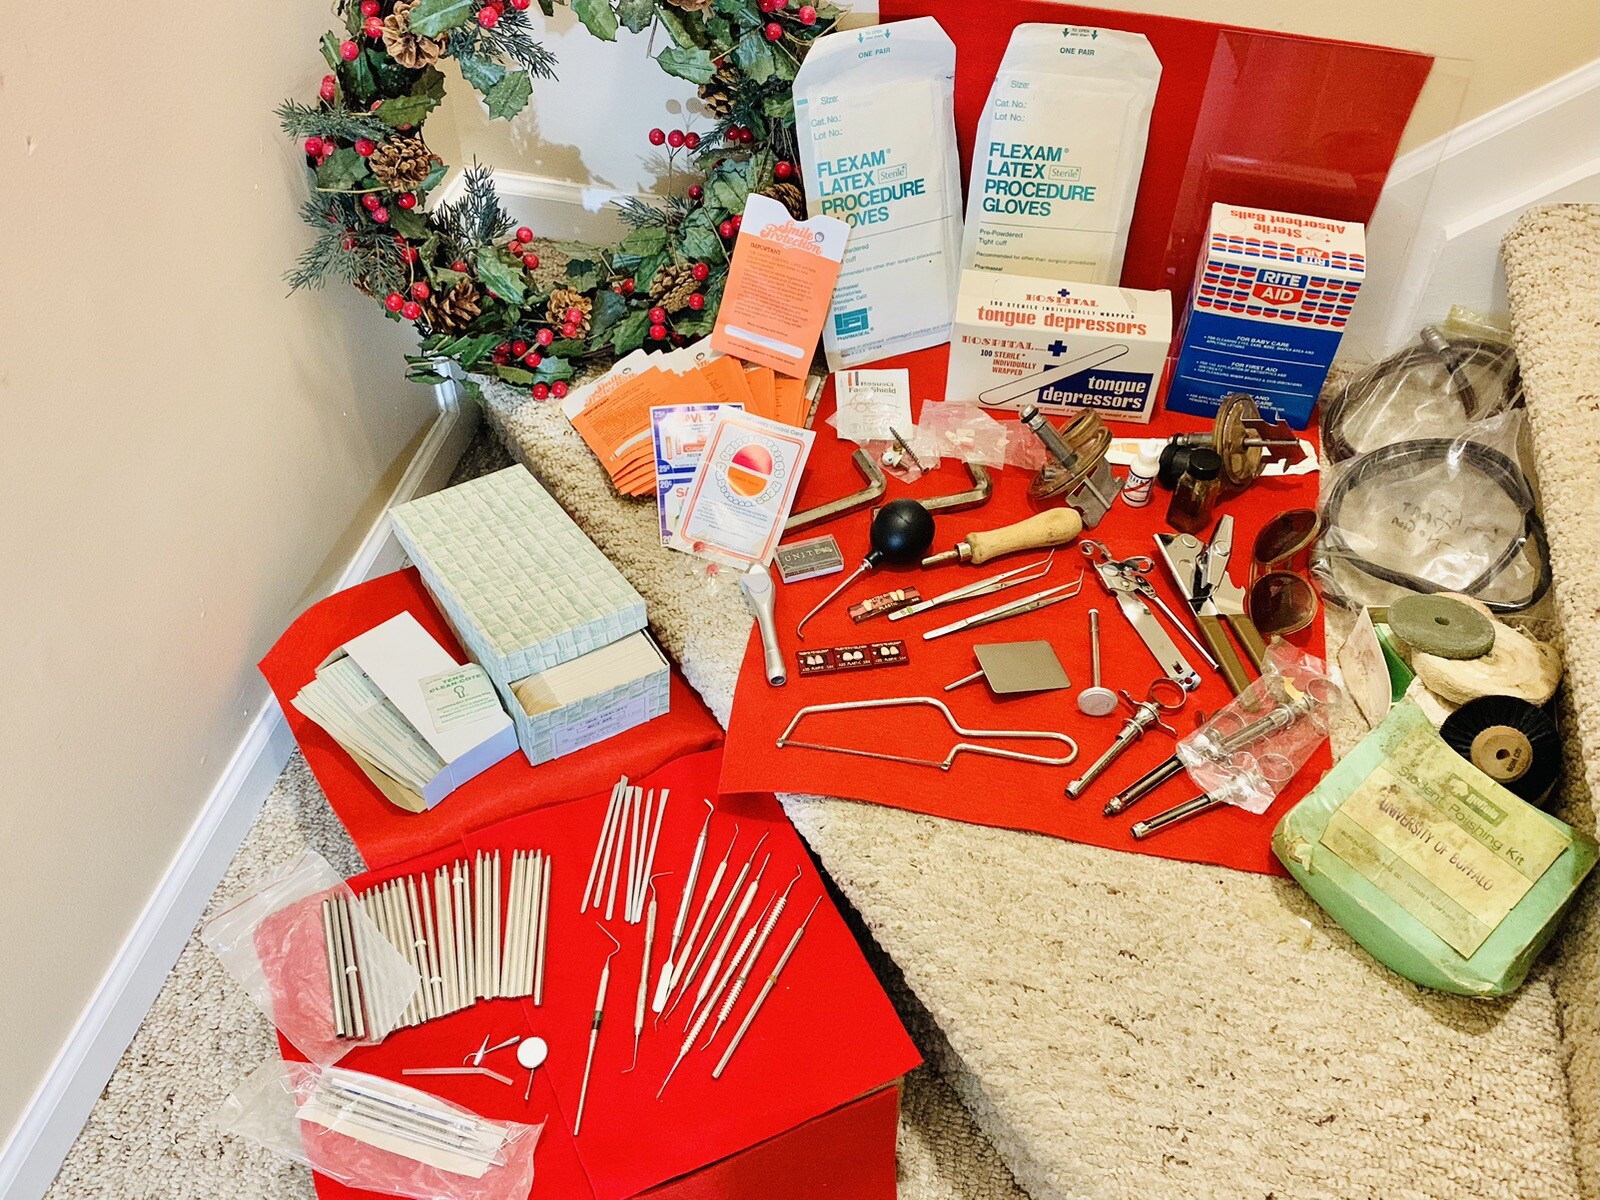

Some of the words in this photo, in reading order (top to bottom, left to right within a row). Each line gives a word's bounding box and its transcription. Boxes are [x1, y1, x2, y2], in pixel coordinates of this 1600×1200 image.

[858, 50, 872, 59] ONE
[875, 47, 891, 55] PAIR
[1059, 47, 1075, 55] ONE
[1077, 48, 1096, 56] PAIR
[1010, 80, 1030, 89] Size:
[820, 95, 839, 105] Size:
[994, 112, 1008, 121] Lot
[813, 130, 827, 141] Lot
[987, 160, 1046, 179] LATEX
[819, 171, 876, 197] LATEX
[985, 179, 1096, 201] PROCEDURE
[821, 178, 926, 215] PROCEDURE
[983, 197, 1051, 217] GLOVES
[1230, 210, 1267, 222] Balls
[1270, 213, 1346, 234] Absorbent
[776, 219, 814, 240] Smile
[979, 228, 1023, 238] Pre-Powdered
[1253, 223, 1302, 238] Sterile
[759, 224, 822, 255] Protection
[978, 237, 994, 246] Tight
[976, 251, 1013, 260] Recommended
[1302, 248, 1323, 257] AID
[1263, 271, 1302, 287] RITE
[1025, 293, 1099, 308] HOSPITAL
[1260, 286, 1294, 301] AID
[1007, 302, 1038, 310] STERILE
[1042, 306, 1097, 316] INDIVIDUALLY
[1100, 311, 1136, 320] WRAPPED
[977, 305, 1036, 327] tongue
[1044, 313, 1147, 336] depressors
[961, 335, 1034, 350] HOSPITAL
[1250, 337, 1271, 345] BABY
[980, 349, 993, 357] 100
[992, 358, 1037, 369] INDIVIDUALLY
[992, 366, 1023, 376] WRAPPED
[1246, 363, 1265, 371] FIRST
[870, 386, 897, 394] Shield
[1088, 375, 1147, 396] tongue
[1042, 386, 1143, 409] depressors
[790, 429, 804, 437] Card
[429, 673, 481, 693] CLEAN-COTE
[442, 674, 465, 684] TENS
[1397, 766, 1447, 807] Student
[1448, 803, 1504, 851] Polishing
[1505, 846, 1526, 866] Kit
[1433, 840, 1448, 856] OF
[1448, 851, 1495, 893] BUFFALO
